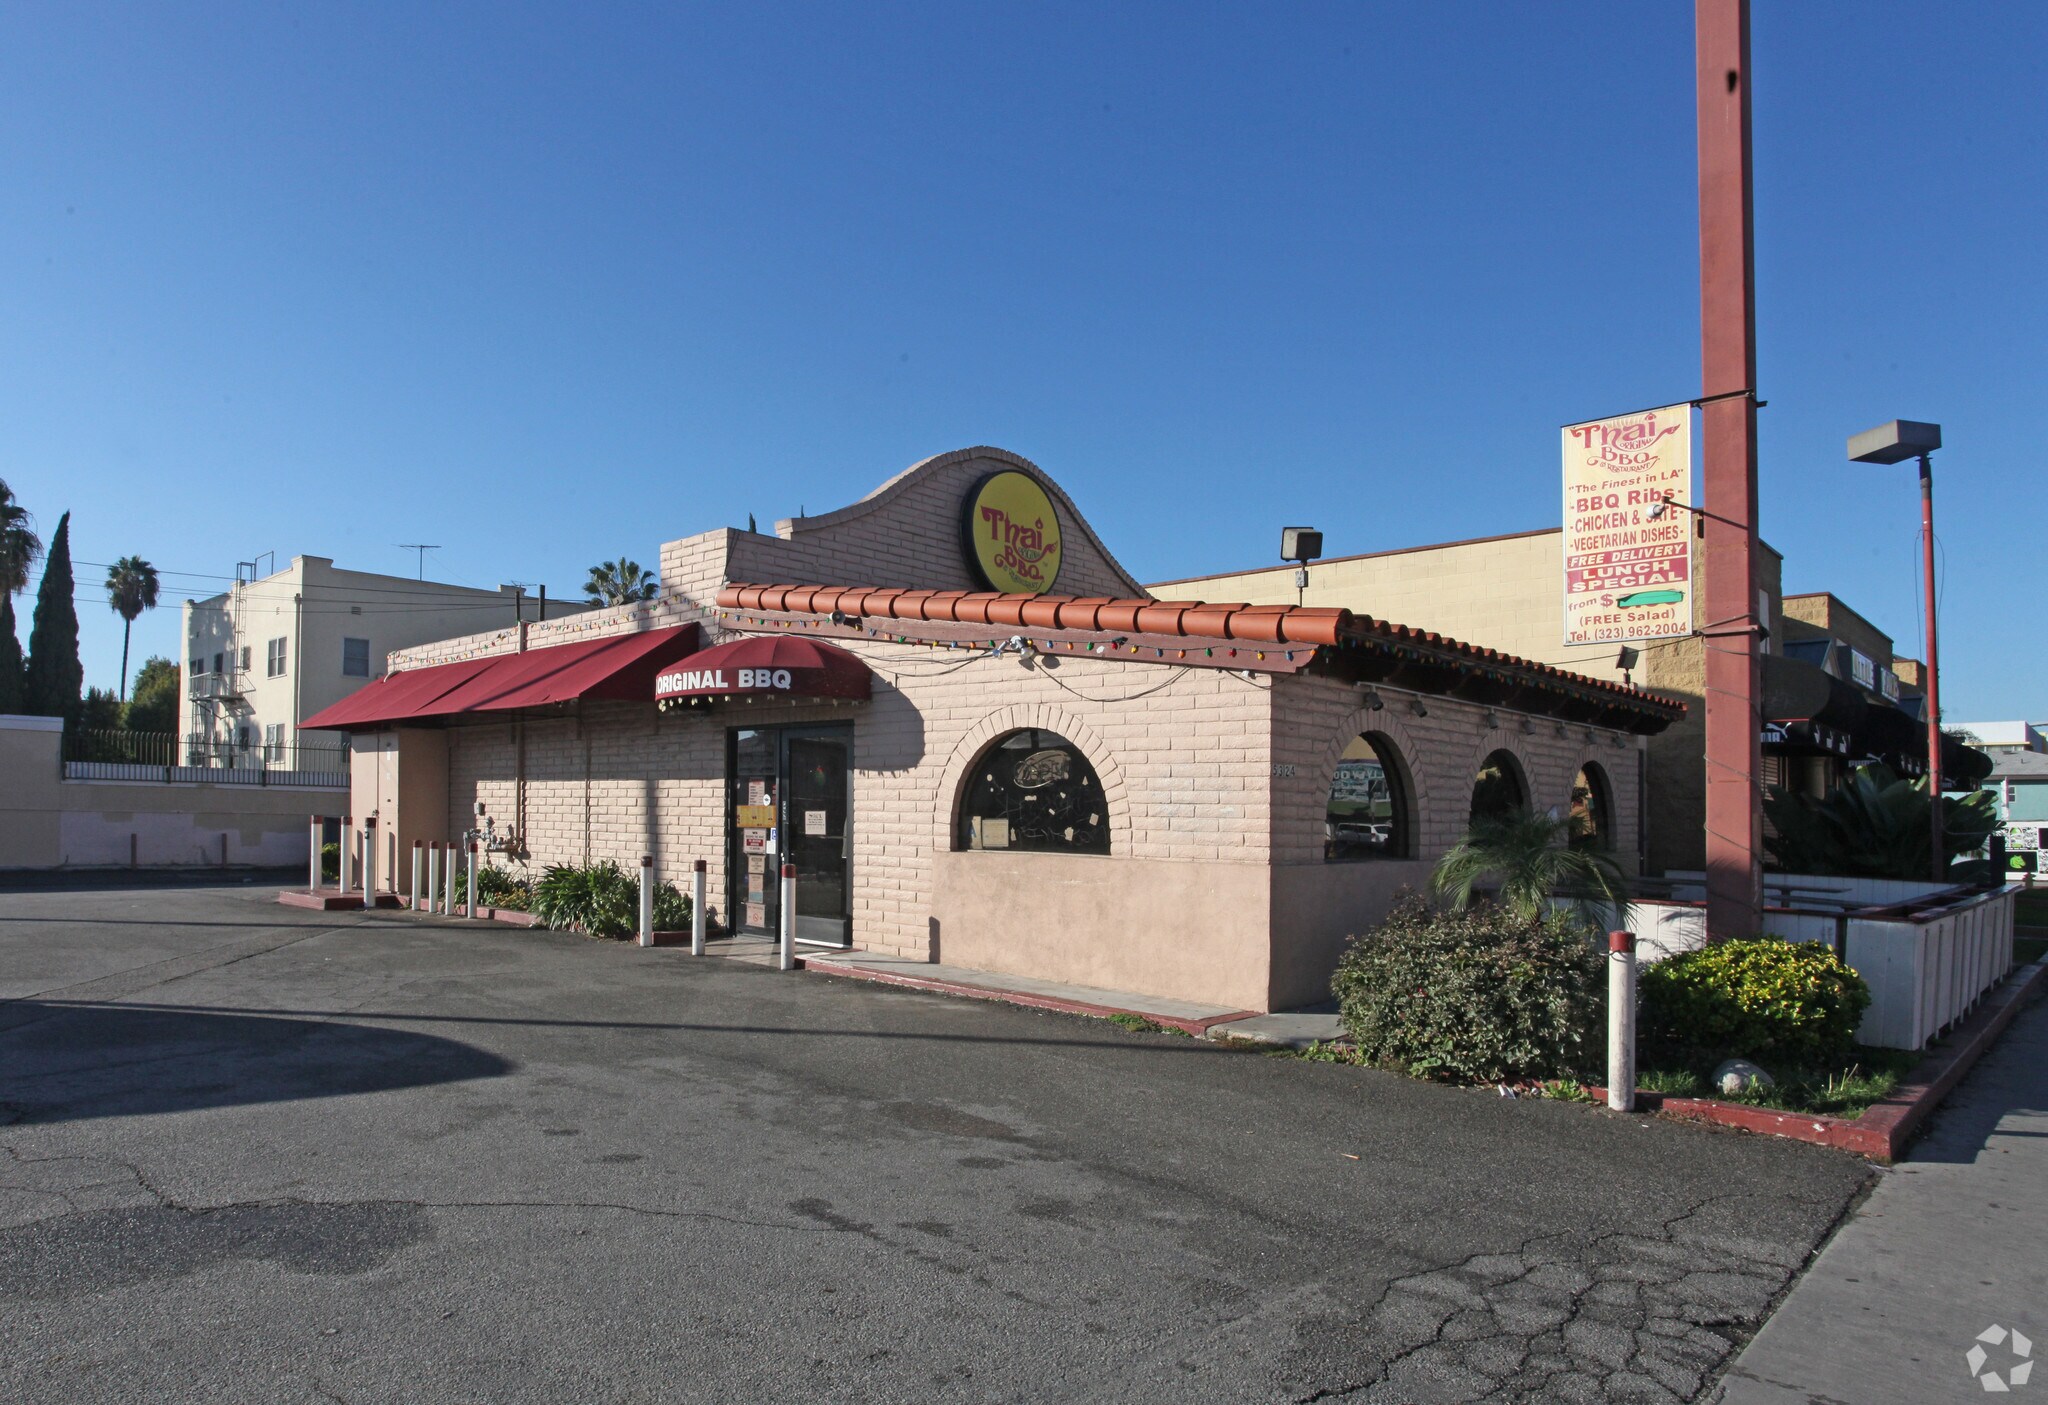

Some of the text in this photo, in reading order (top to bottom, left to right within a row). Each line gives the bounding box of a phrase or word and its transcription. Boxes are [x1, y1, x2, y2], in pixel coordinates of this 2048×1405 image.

[1570, 412, 1657, 449] Thai
[1601, 447, 1658, 465] BBQ
[1607, 463, 1650, 472] RESTAURANT
[1602, 476, 1641, 489] Finest
[1646, 474, 1656, 482] in
[1632, 510, 1640, 525] &
[981, 505, 1044, 550] Thai
[1004, 544, 1045, 580] BBQ
[1570, 544, 1684, 567] FREE DELIVERY
[1582, 560, 1670, 580] LUNCH
[1572, 572, 1683, 591] SPECIAL
[1569, 598, 1597, 611] from
[1580, 608, 1675, 626] (FREE Salad)
[1570, 622, 1687, 642] Tel. (323) 962-2004
[657, 670, 728, 694] ORIGINAL
[738, 669, 791, 690] BBQ
[1273, 765, 1295, 777] 5324
